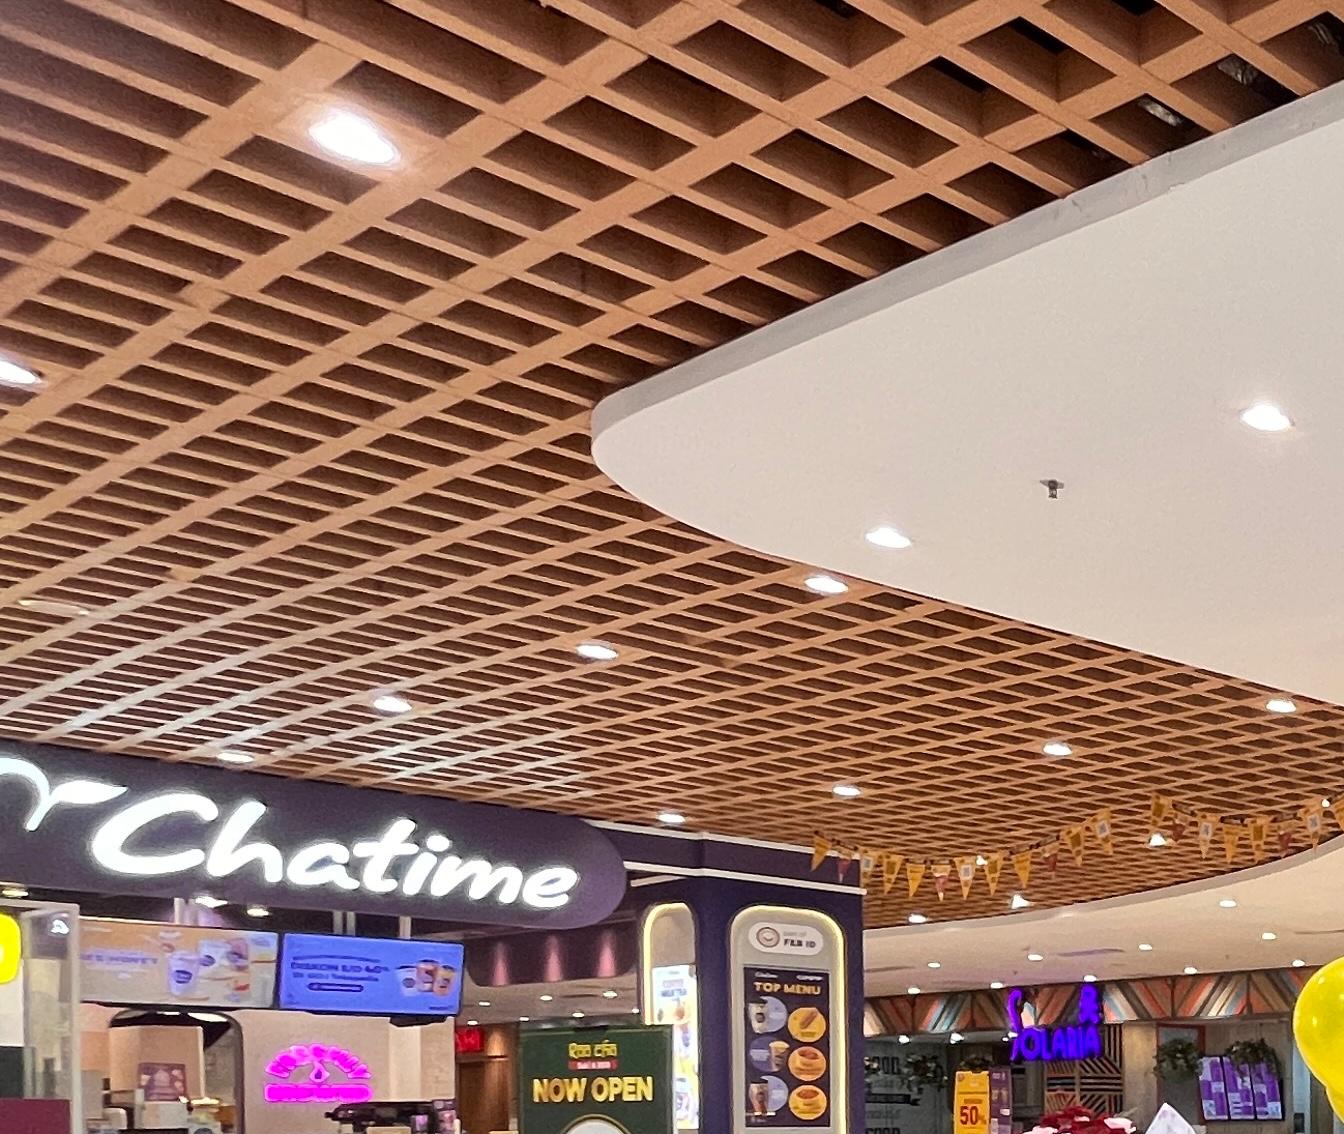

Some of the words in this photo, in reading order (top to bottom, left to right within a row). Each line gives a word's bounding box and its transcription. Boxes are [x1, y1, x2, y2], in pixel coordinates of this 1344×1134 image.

[92, 793, 580, 908] Chatime
[753, 981, 781, 993] TOP
[783, 984, 821, 995] MENU
[533, 1078, 587, 1102] NOW
[591, 1076, 653, 1102] OPEN
